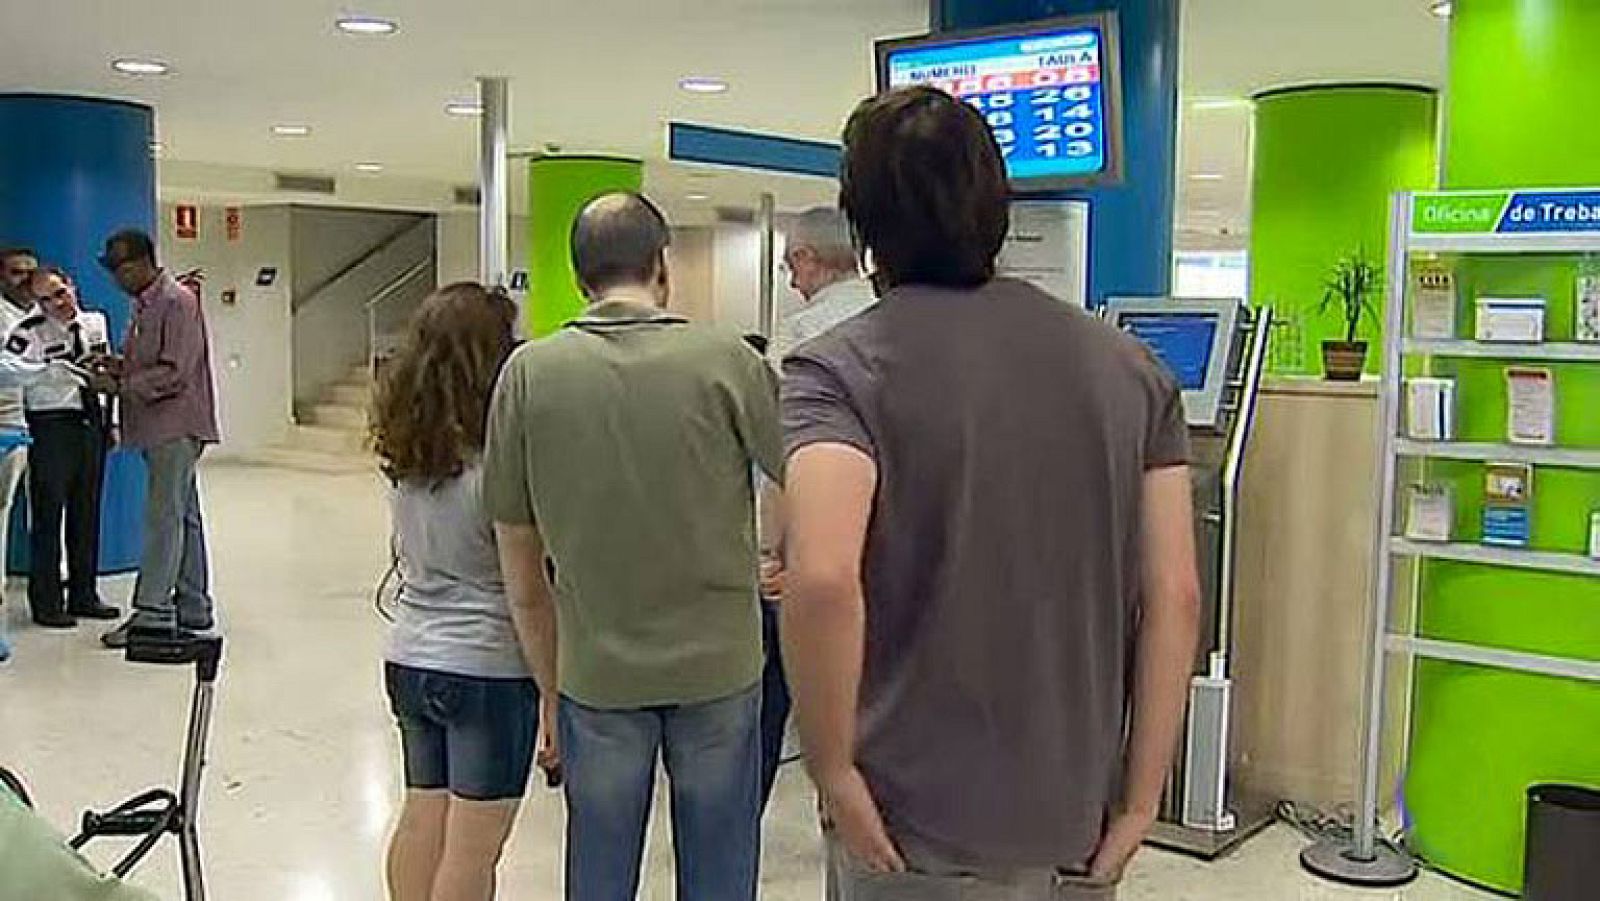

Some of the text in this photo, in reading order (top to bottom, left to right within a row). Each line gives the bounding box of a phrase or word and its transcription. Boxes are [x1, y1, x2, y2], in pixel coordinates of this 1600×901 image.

[1032, 103, 1093, 121] 14
[1032, 121, 1095, 141] 20
[1509, 204, 1537, 221] de
